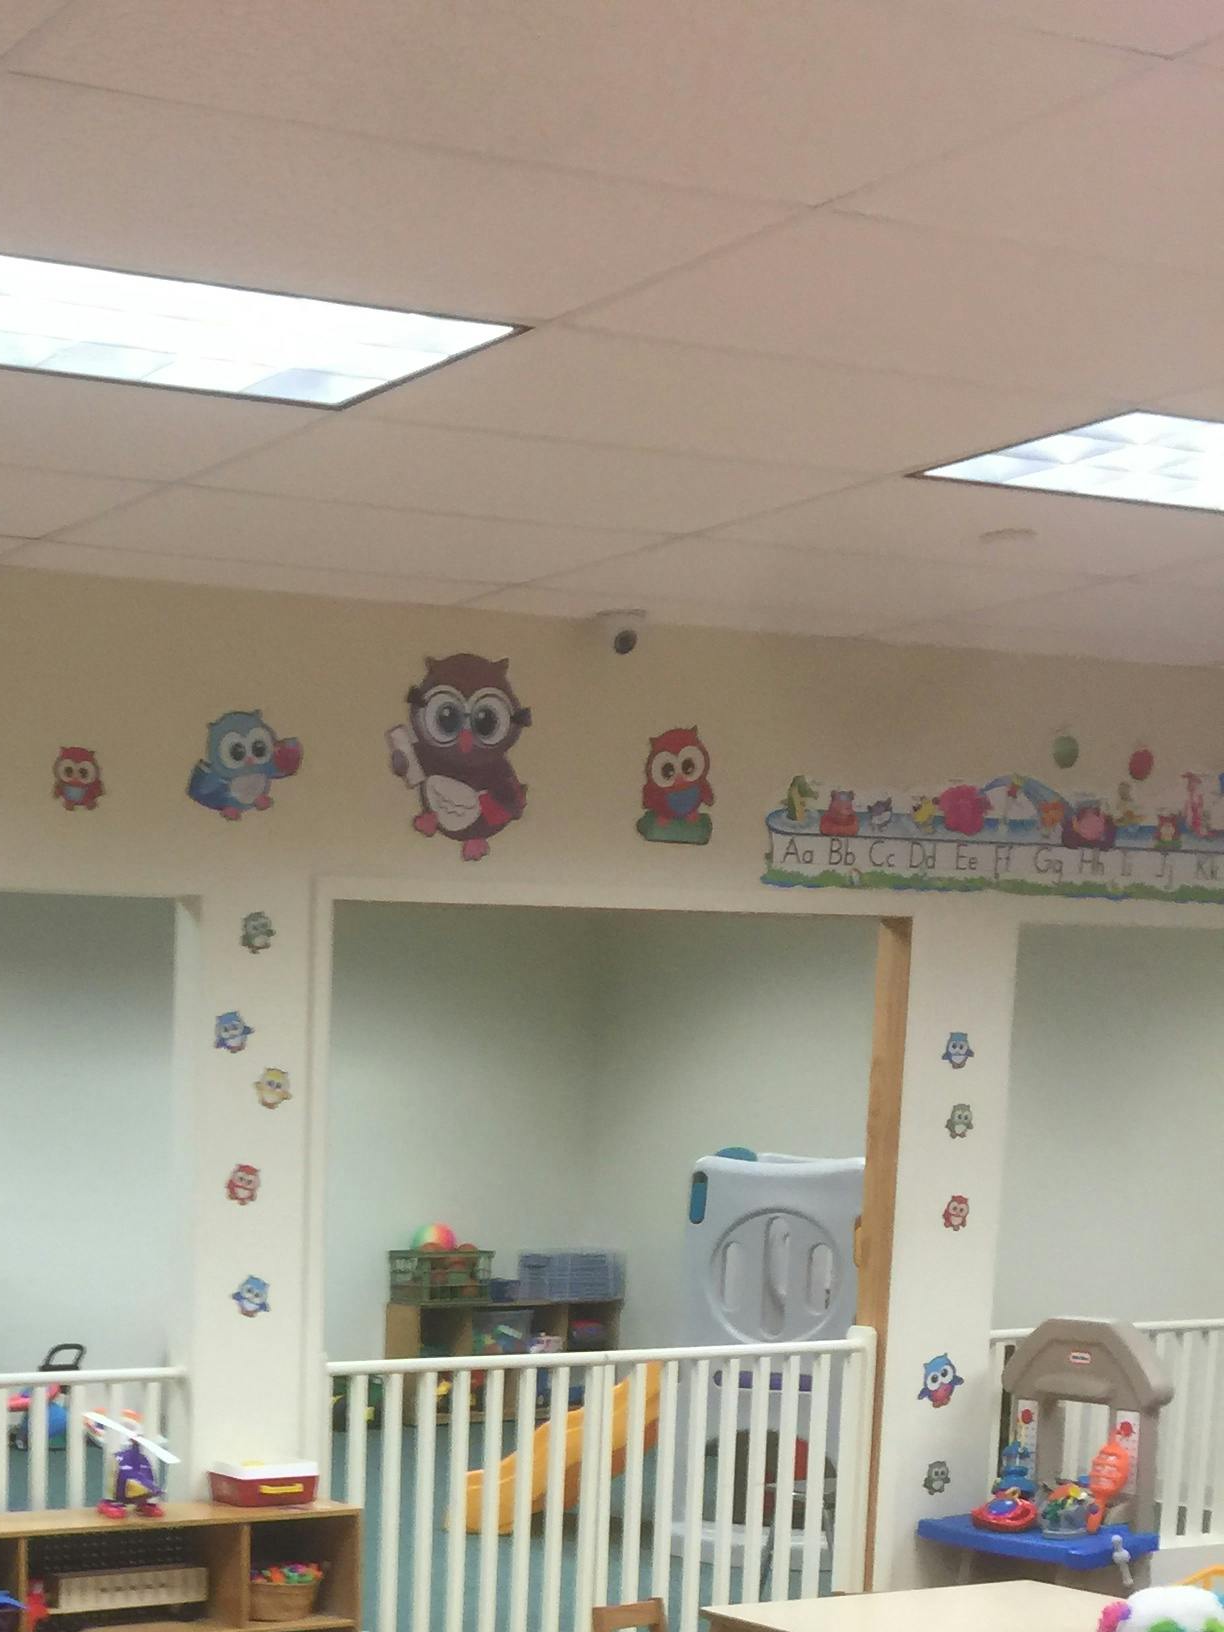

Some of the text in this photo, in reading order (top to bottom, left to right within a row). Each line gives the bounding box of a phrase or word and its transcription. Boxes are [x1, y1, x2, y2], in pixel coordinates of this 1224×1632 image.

[780, 837, 815, 865] Aa
[828, 837, 857, 866] Bb
[869, 840, 895, 868] Cc
[908, 841, 936, 870] Dd
[956, 843, 979, 871] Ee
[993, 845, 1014, 877] Ff
[1033, 847, 1064, 886] Gg
[1078, 850, 1105, 876] Hh
[1195, 852, 1220, 881] Kk
